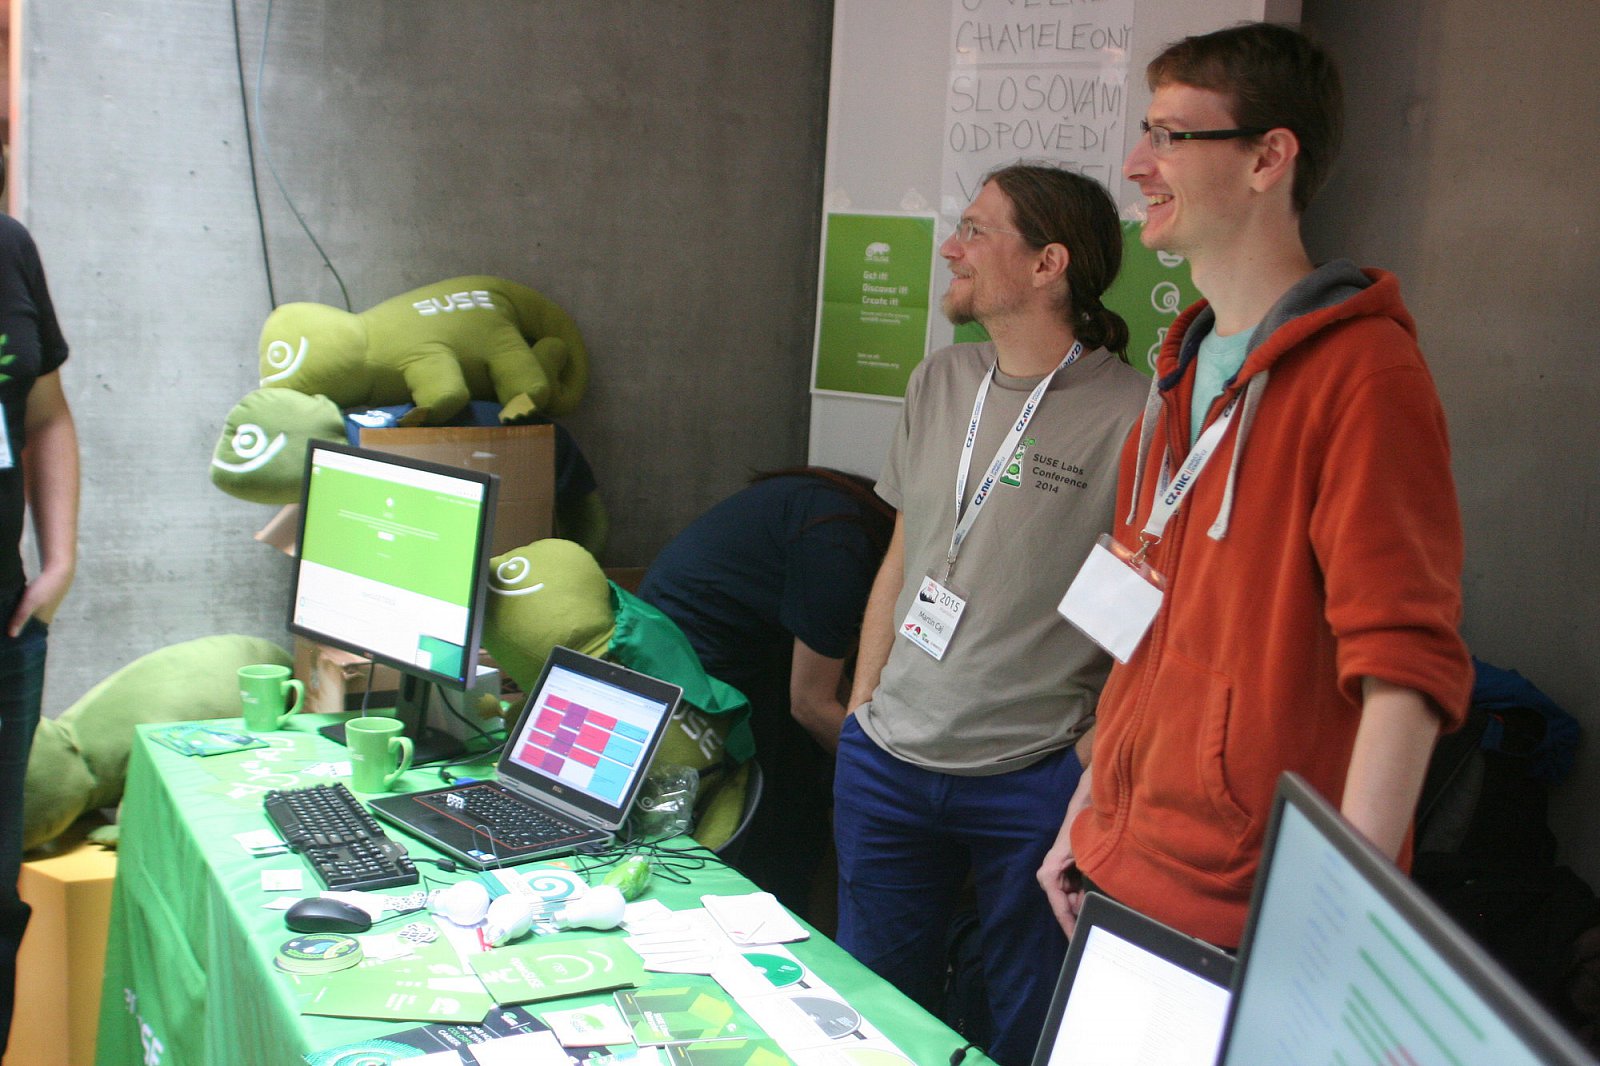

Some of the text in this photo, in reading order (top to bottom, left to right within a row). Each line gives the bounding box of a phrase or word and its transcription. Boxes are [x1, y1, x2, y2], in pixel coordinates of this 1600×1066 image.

[950, 116, 1116, 152] ODPOVĚDÍ
[412, 290, 495, 316] SUSE
[1033, 453, 1084, 475] SUSE Labs
[1032, 466, 1088, 489] Conference
[1035, 480, 1059, 494] 2014
[940, 592, 960, 613] 2015
[437, 1029, 462, 1046] CAREER
